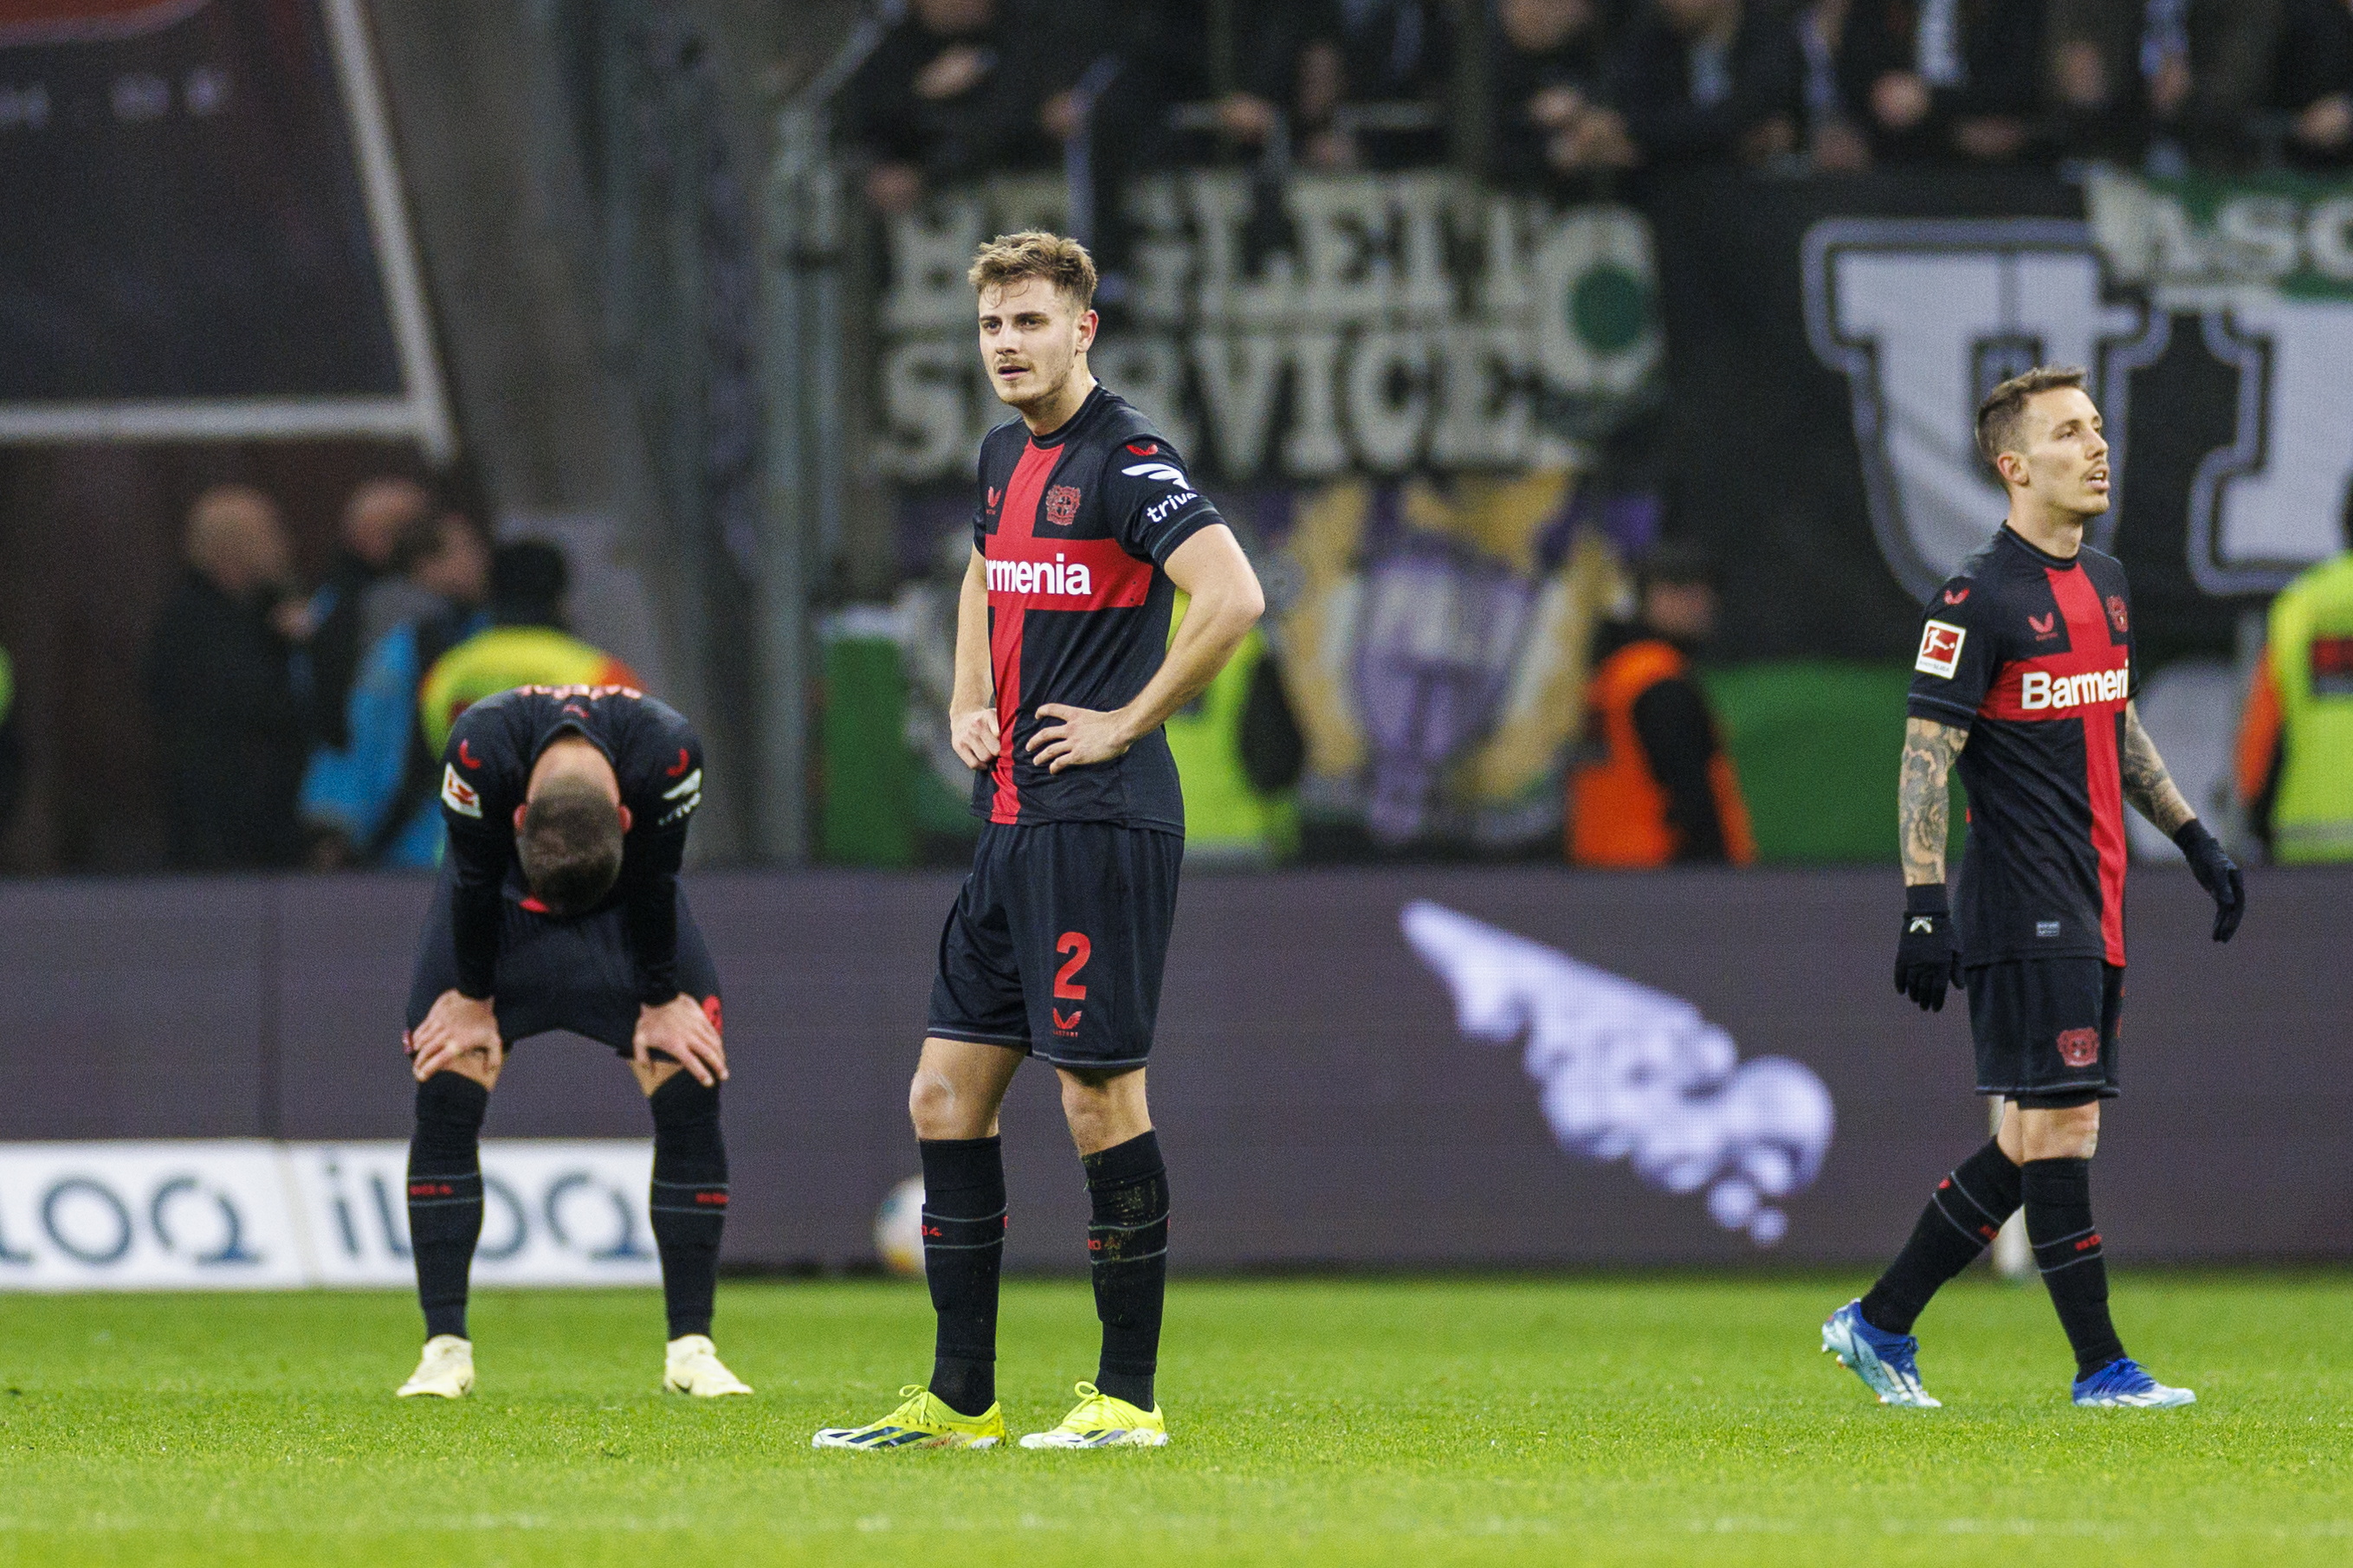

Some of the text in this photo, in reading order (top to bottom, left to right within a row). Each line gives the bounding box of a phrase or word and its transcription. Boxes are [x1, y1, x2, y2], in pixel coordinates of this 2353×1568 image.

[876, 329, 1542, 476] SRVICE
[985, 552, 1092, 596] rmenia
[1053, 931, 1091, 1001] 2
